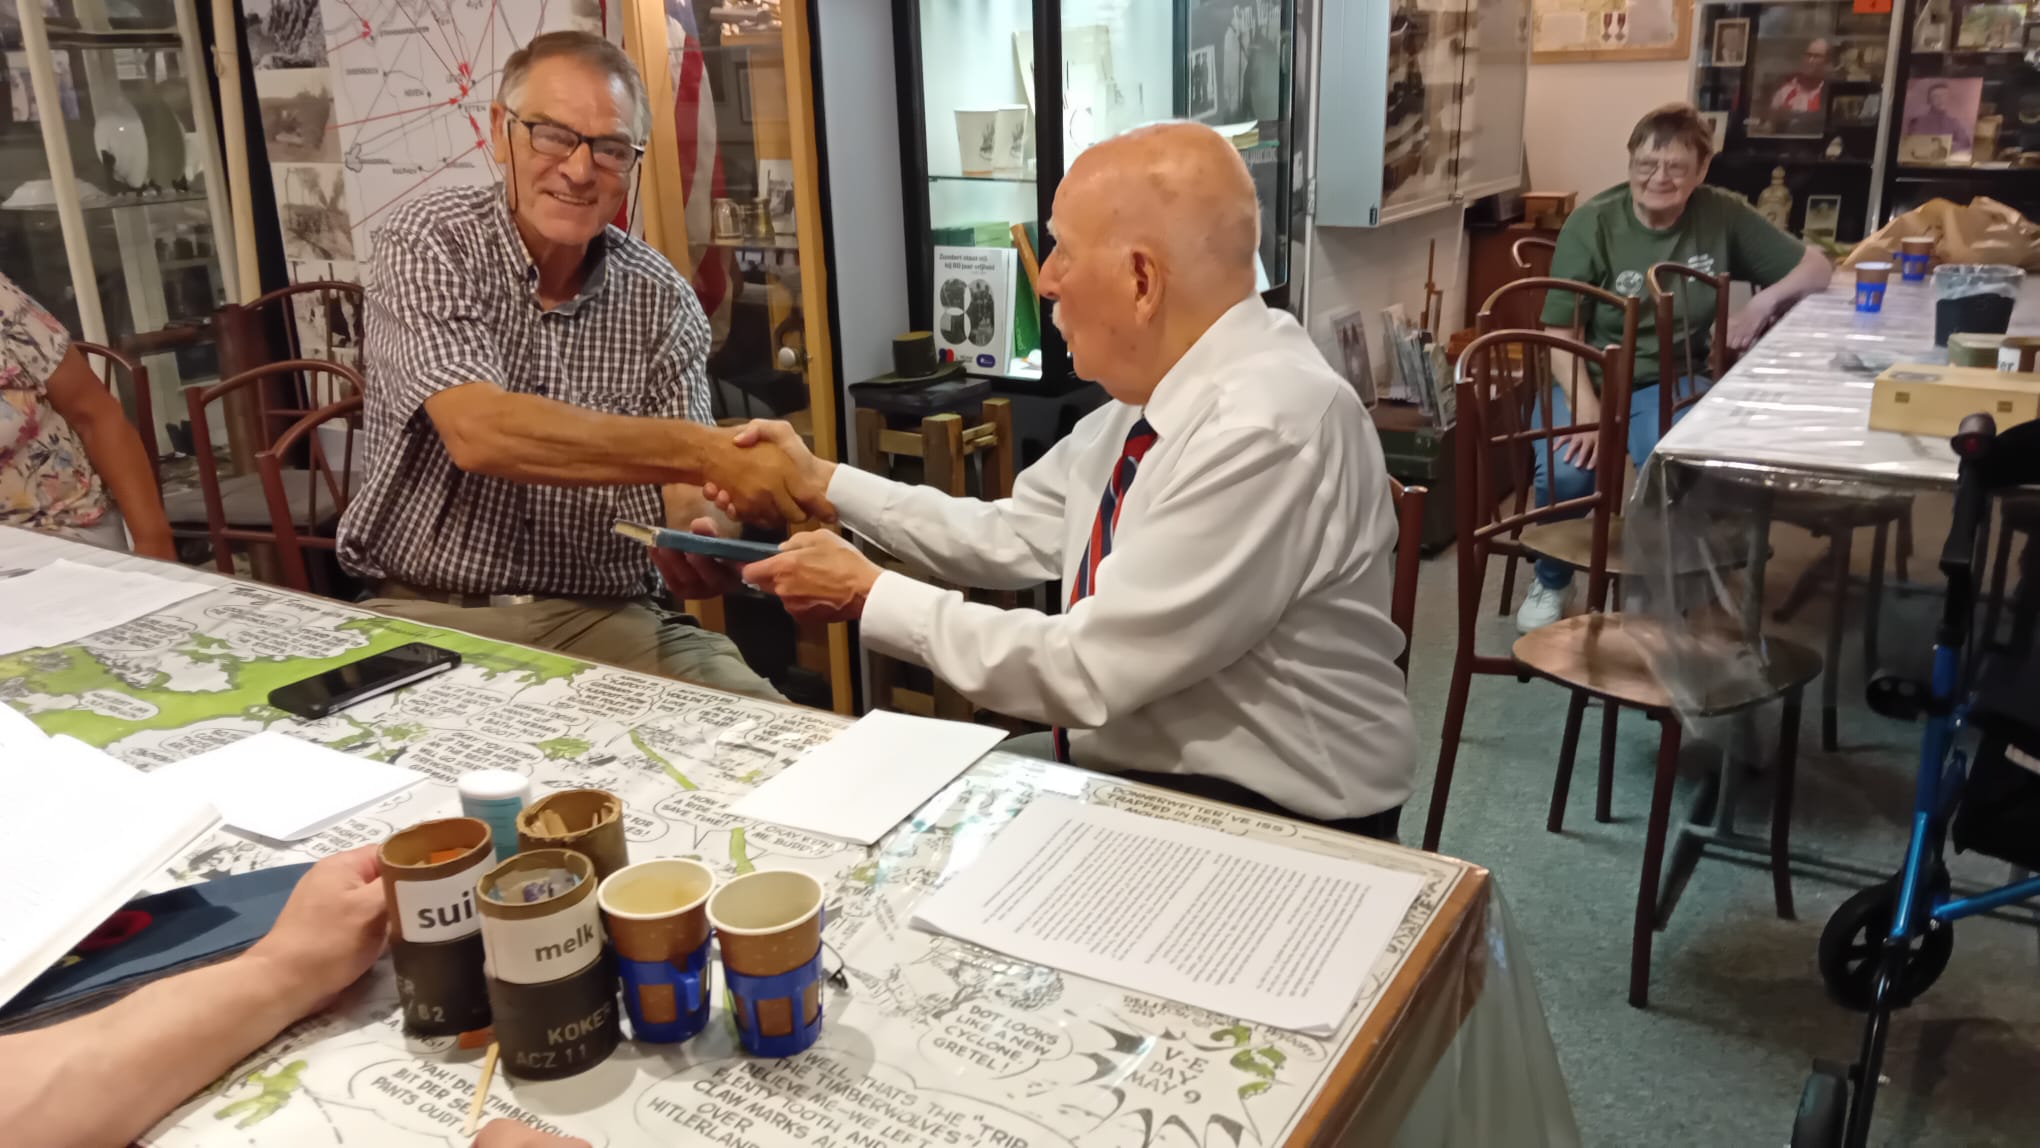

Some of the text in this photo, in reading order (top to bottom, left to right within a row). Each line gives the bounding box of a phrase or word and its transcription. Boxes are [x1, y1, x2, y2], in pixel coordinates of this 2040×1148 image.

[661, 803, 731, 828] SAVE TIME!
[1107, 793, 1172, 814] TRAPPED
[1174, 811, 1191, 819] IN
[1193, 815, 1224, 828] DER
[417, 891, 480, 929] sui
[535, 922, 595, 963] melk
[954, 1013, 1052, 1058] LIKE A NEW
[968, 1003, 1059, 1047] DOT LOOKS
[515, 1050, 560, 1069] ACZ
[773, 1056, 810, 1079] THE
[1148, 1060, 1198, 1086] DAY
[1163, 1046, 1210, 1075] V-E
[371, 1076, 464, 1130] PANTS OUDT
[392, 1067, 491, 1119] BIT DER SET
[451, 1079, 477, 1098] DE
[739, 1060, 811, 1099] BELIEVE
[879, 1125, 934, 1148] LEFT
[803, 1051, 853, 1084] WELL,
[927, 1101, 966, 1128] THE
[1123, 1068, 1202, 1105] MAY 9
[692, 1078, 748, 1109] CLAW
[745, 1102, 810, 1140] MARKS
[696, 1102, 754, 1135] OVER
[711, 1066, 888, 1148] PLENTY TOOTH AND
